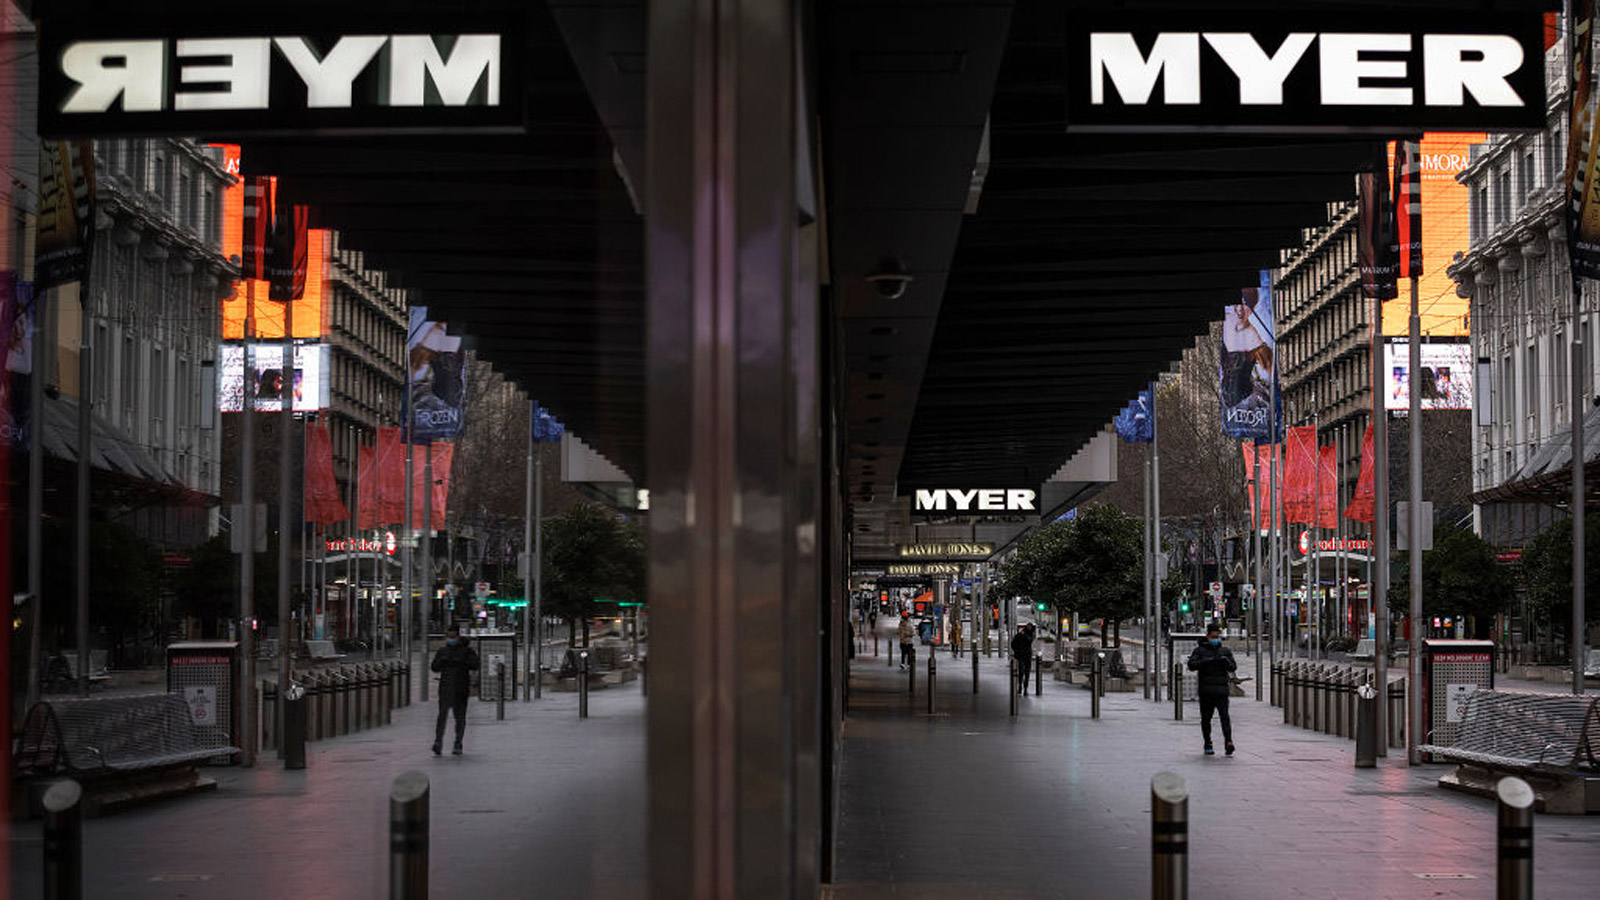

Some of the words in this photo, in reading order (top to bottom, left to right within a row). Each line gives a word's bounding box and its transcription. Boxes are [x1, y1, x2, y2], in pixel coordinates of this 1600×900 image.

[1090, 32, 1526, 107] MYER
[915, 488, 1037, 510] MYER
[901, 544, 942, 556] DAVID
[946, 543, 992, 556] JONES
[888, 564, 921, 574] DAVID
[923, 564, 960, 574] JONES
